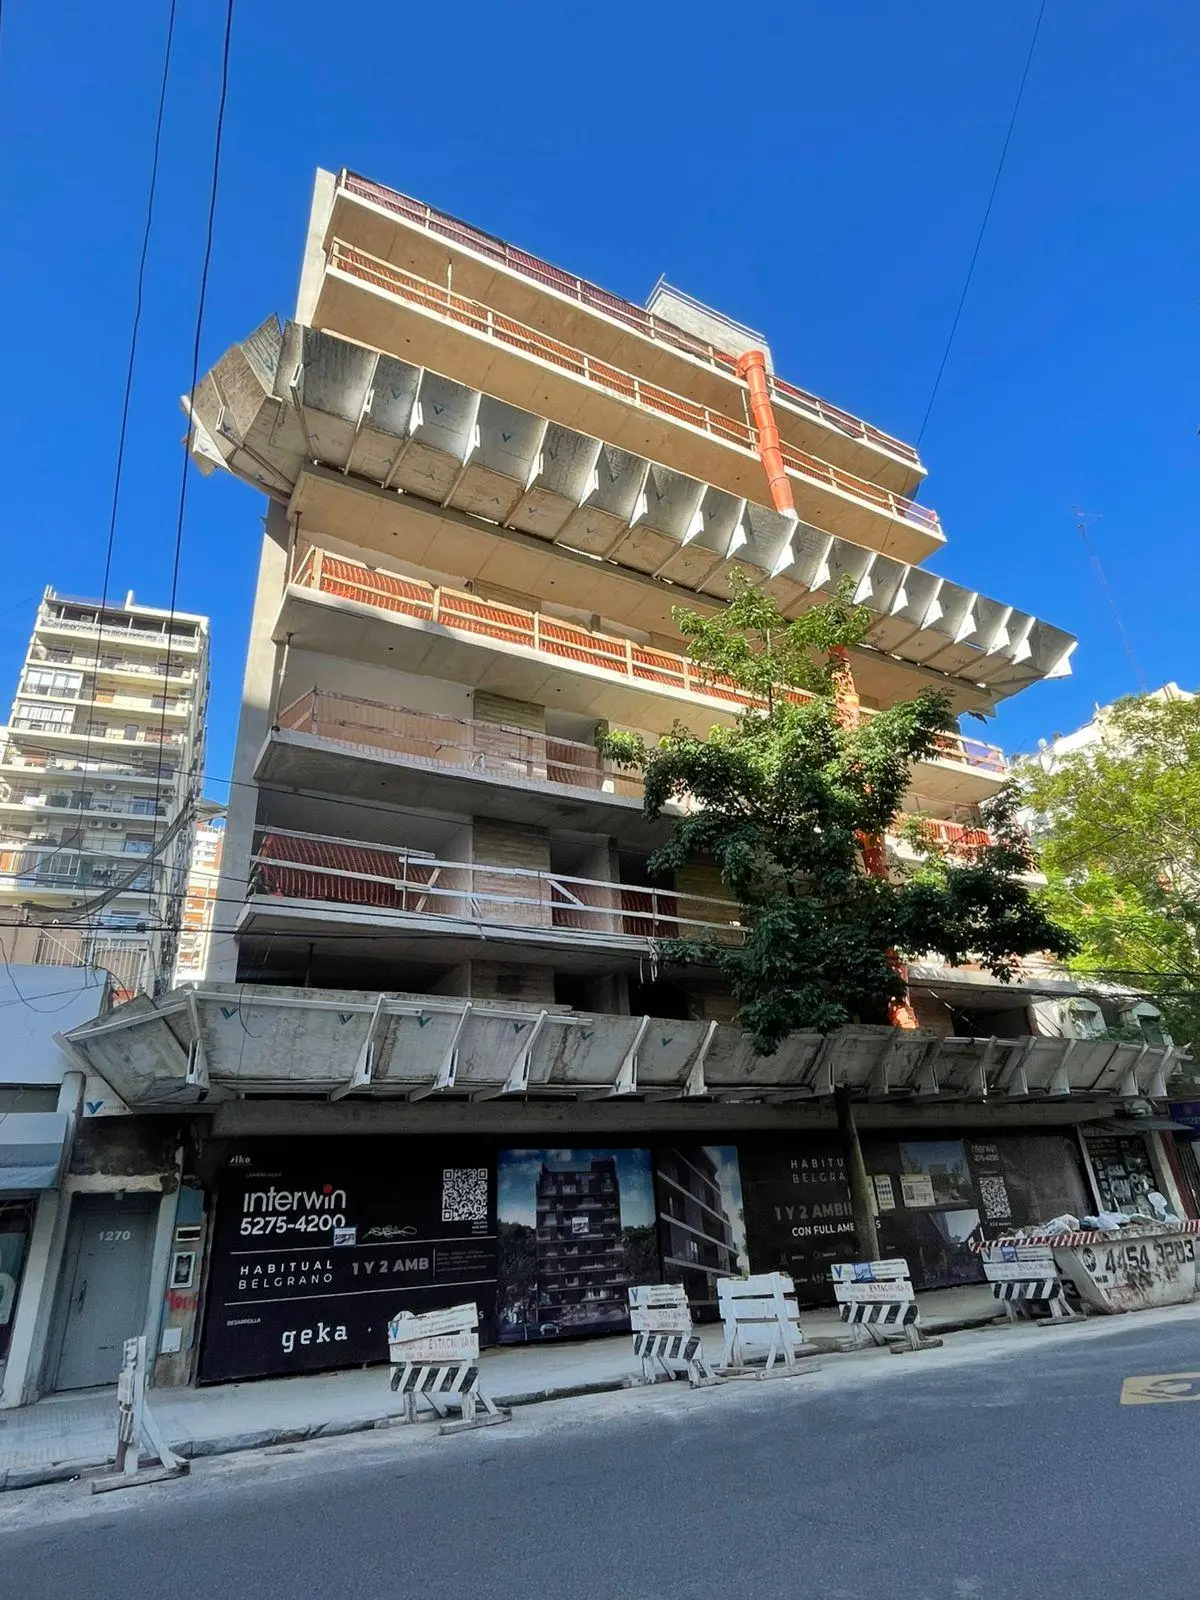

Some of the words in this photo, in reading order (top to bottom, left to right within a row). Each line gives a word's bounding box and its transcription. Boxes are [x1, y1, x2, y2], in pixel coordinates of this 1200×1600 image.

[791, 1158, 844, 1169] HABITU
[792, 1171, 847, 1184] BELGRA
[243, 1184, 346, 1213] interwin
[799, 1205, 808, 1219] 2
[240, 1214, 345, 1236] 5275-4200
[791, 1226, 812, 1237] CON
[813, 1224, 835, 1235] FULL
[99, 1231, 131, 1241] 1270
[240, 1260, 333, 1276] HABITUAL
[352, 1262, 359, 1275] 1
[364, 1261, 374, 1274] Y
[379, 1260, 388, 1273] 2
[392, 1257, 430, 1272] AMB
[238, 1274, 333, 1290] BELGRANO
[282, 1322, 348, 1353] geka
